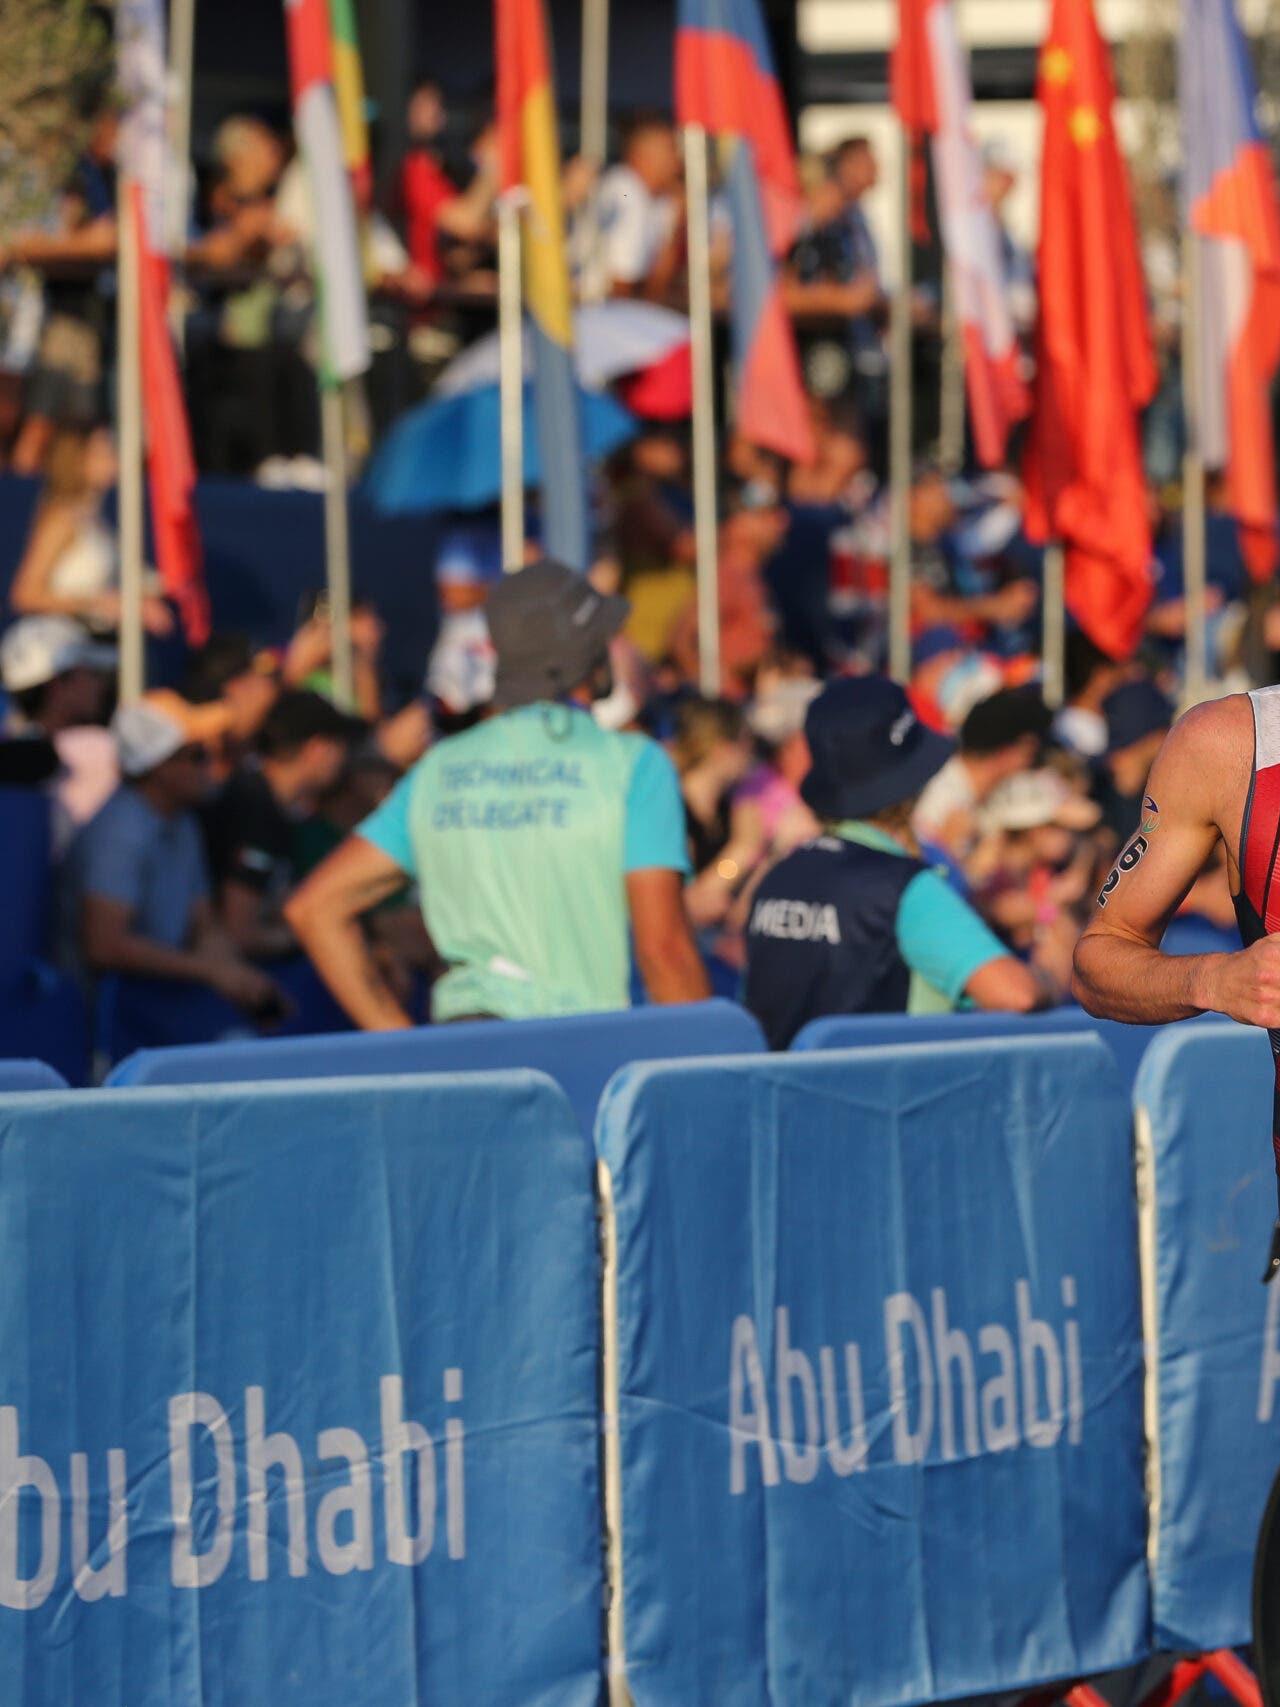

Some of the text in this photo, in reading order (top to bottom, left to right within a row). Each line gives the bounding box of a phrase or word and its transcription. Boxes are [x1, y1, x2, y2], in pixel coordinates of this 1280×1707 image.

[751, 898, 841, 944] MEDIA
[0, 1367, 466, 1611] bu Dhabi
[730, 1305, 868, 1495] Abu
[883, 1275, 1084, 1465] Dhabi
